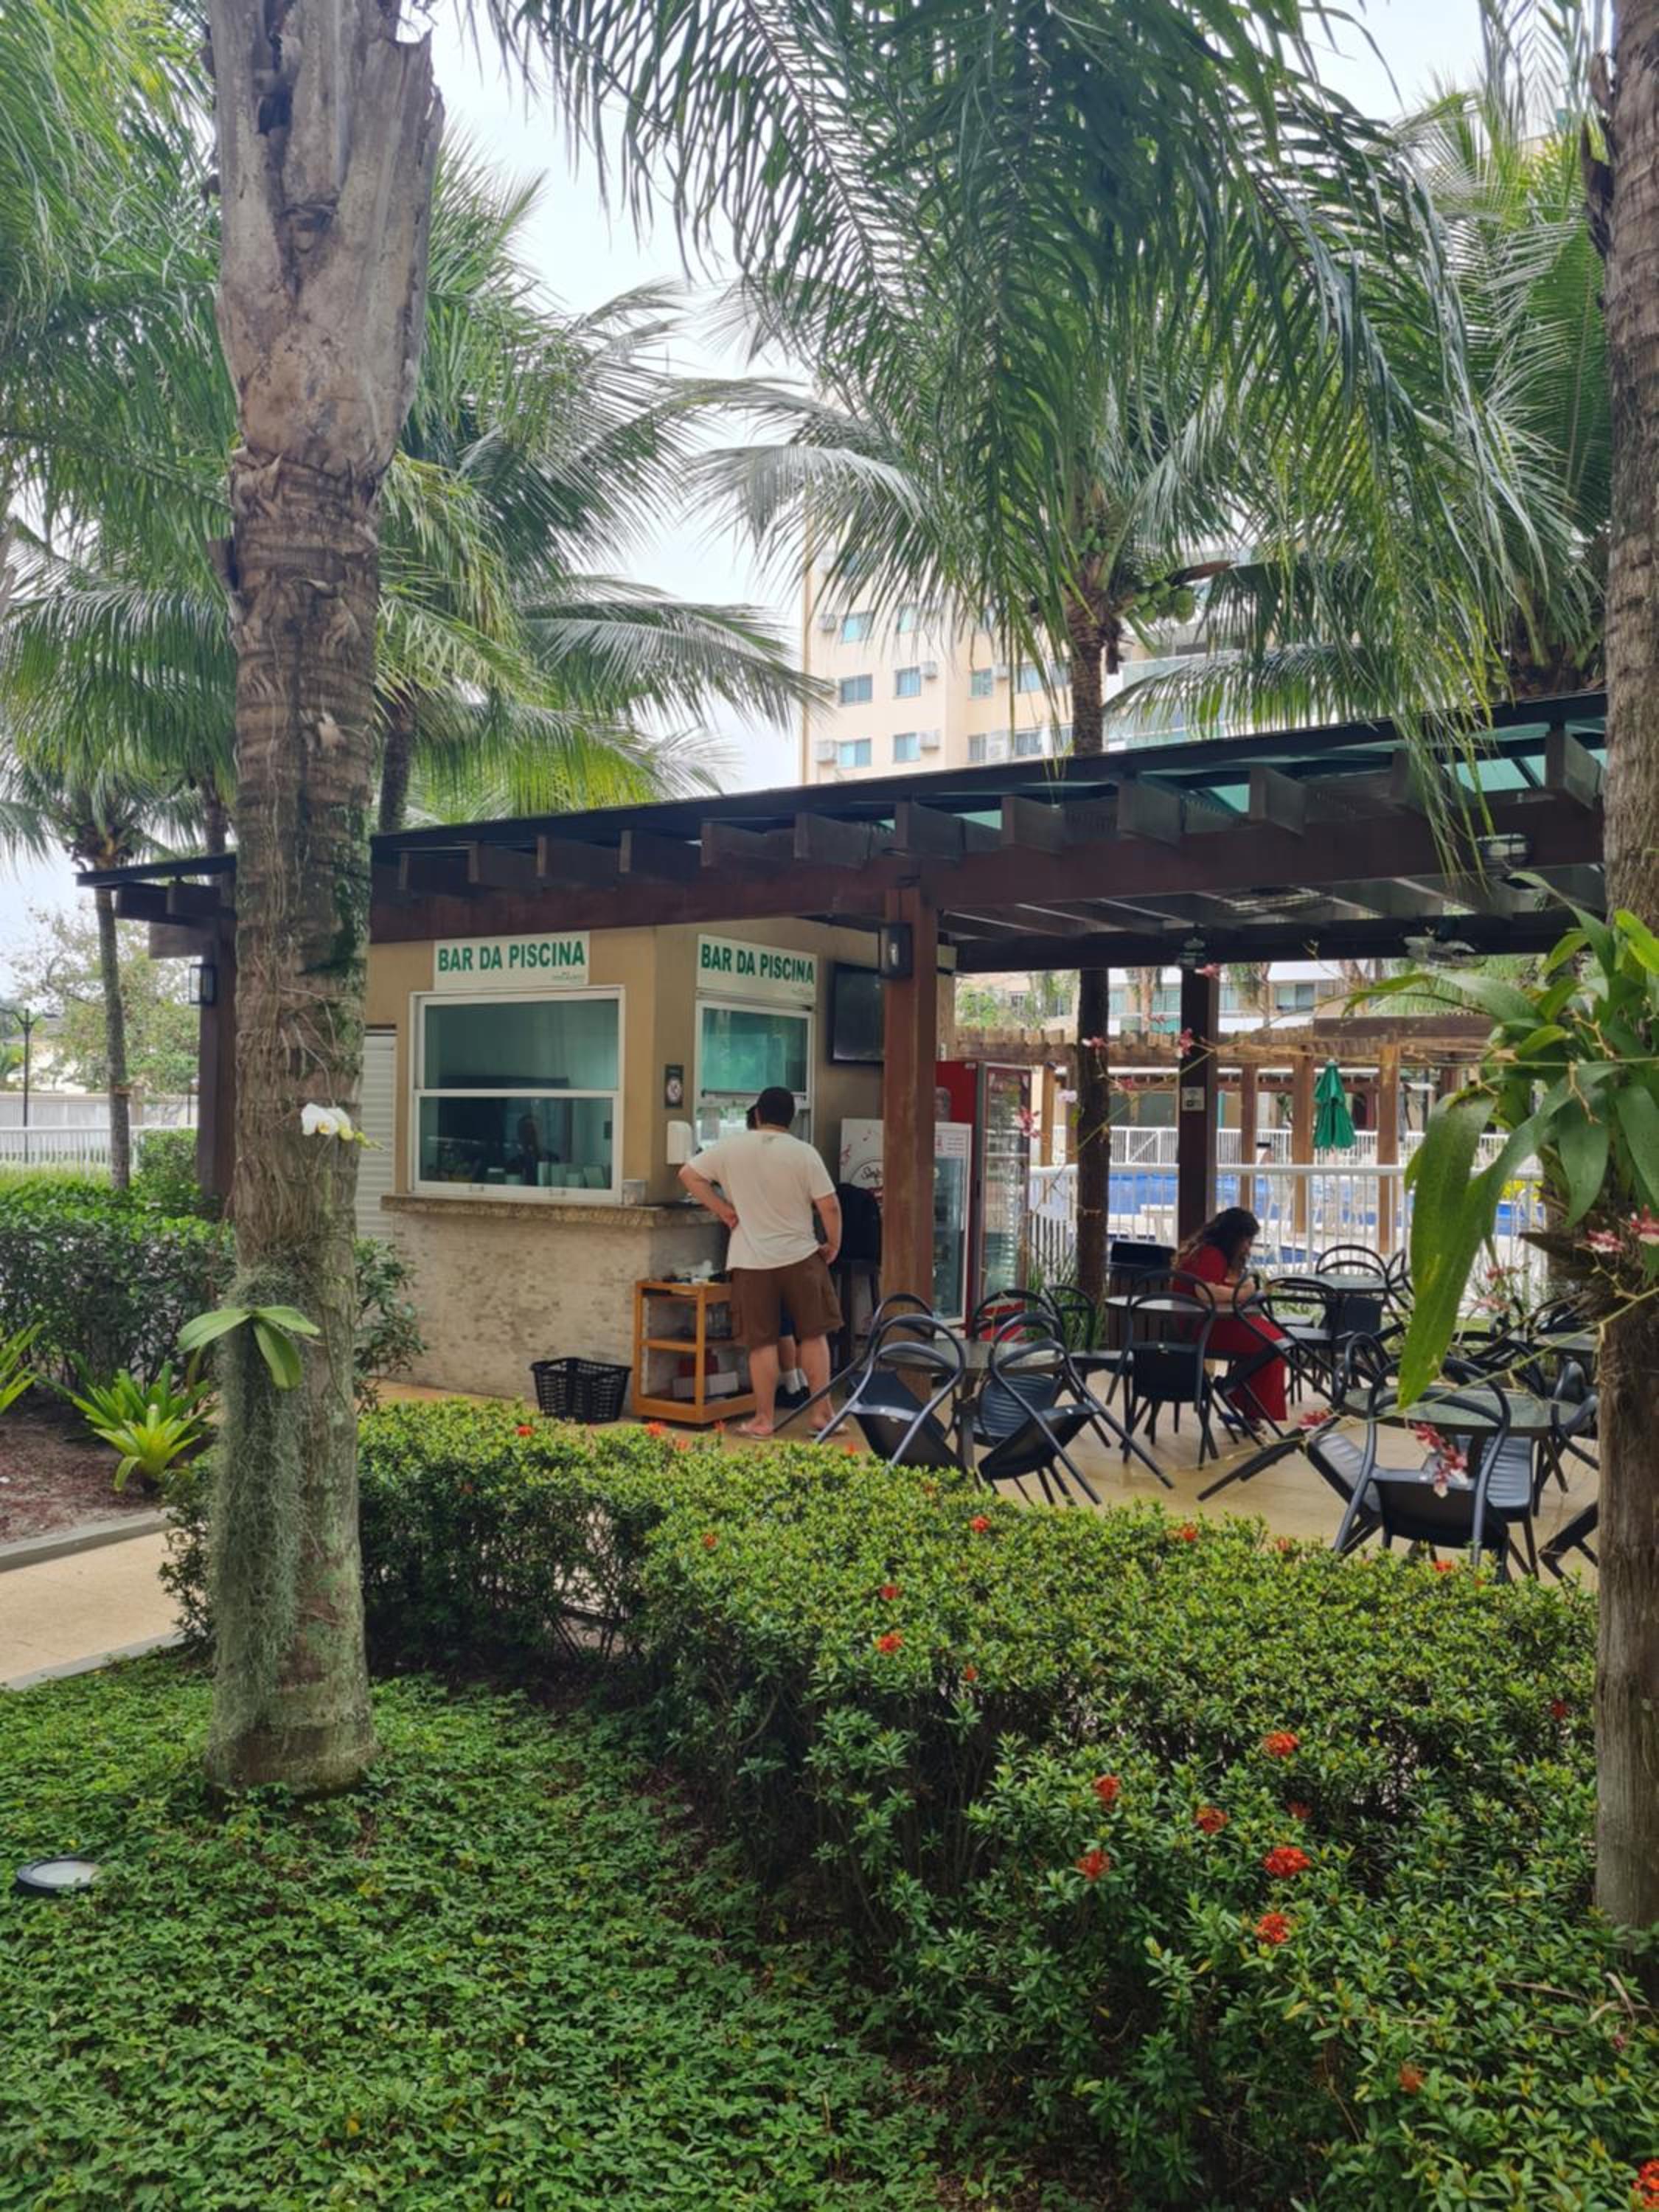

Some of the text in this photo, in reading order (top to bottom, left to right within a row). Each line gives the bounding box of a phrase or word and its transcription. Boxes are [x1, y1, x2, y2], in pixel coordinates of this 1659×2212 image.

[438, 940, 585, 972] BAR DA PISCINA
[701, 943, 815, 985] BAR DA PISCINA
